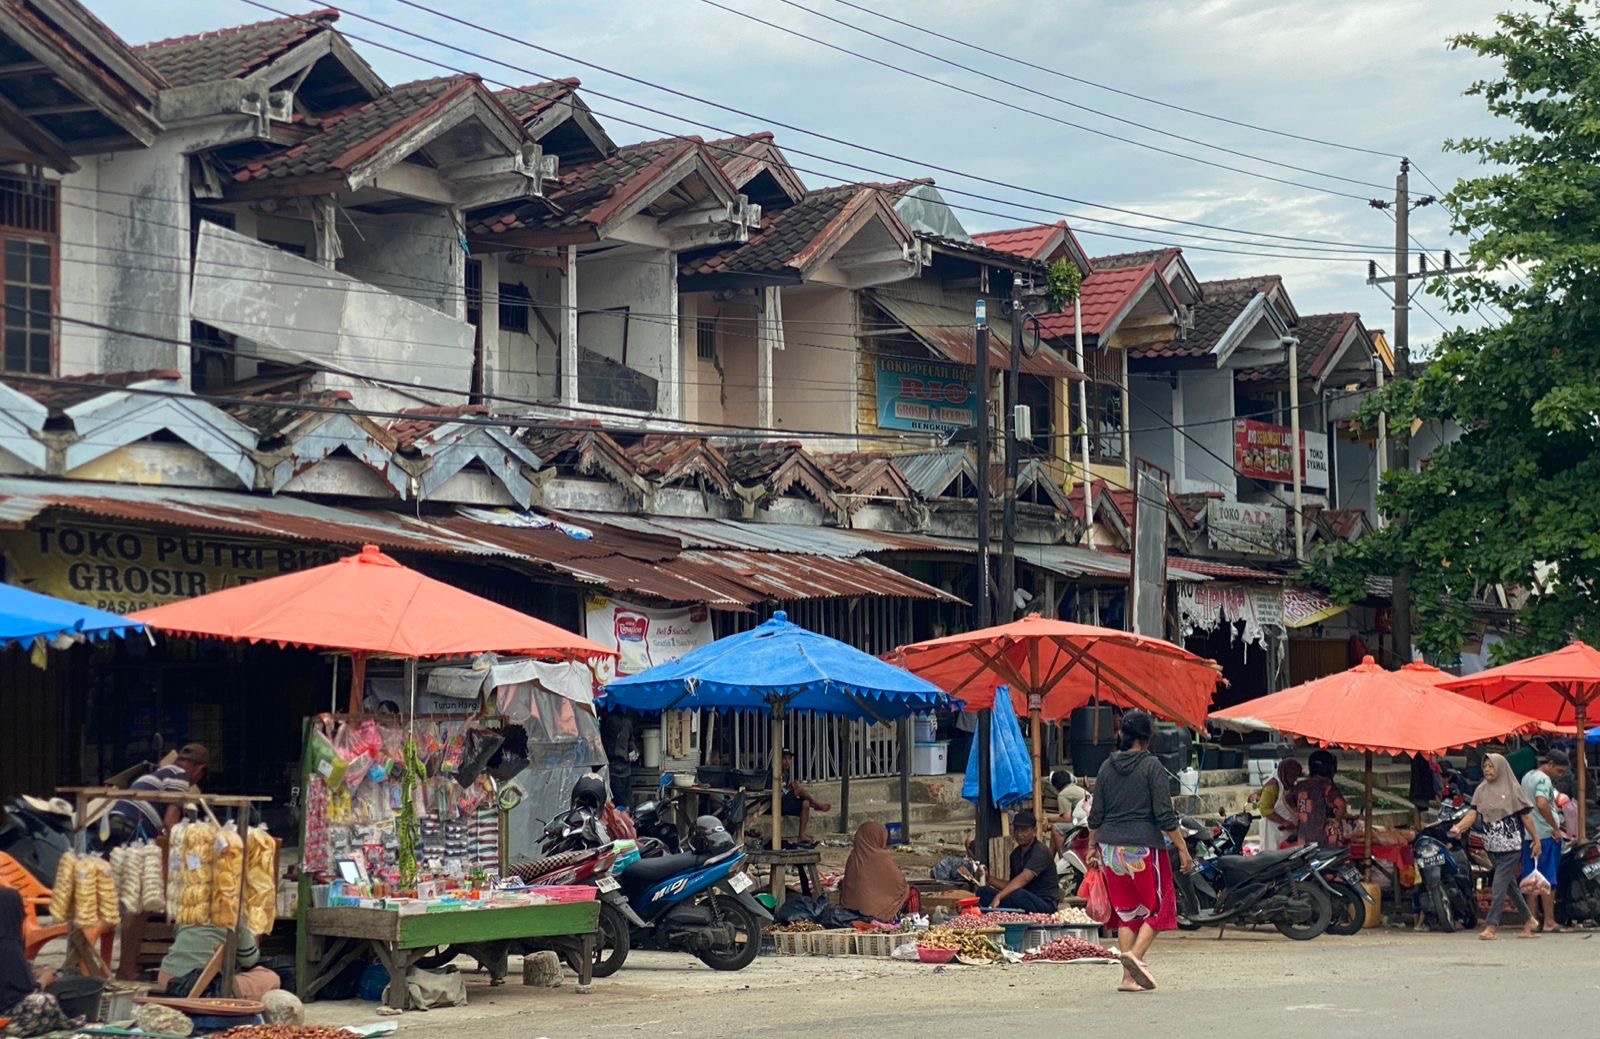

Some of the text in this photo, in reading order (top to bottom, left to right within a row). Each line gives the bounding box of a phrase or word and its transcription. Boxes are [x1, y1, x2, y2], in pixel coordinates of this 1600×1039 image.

[899, 376, 968, 404] RIO
[912, 421, 957, 432] BENGKU
[1309, 448, 1323, 460] TOKO
[1306, 459, 1327, 472] SYAWAL
[1219, 506, 1239, 521] TOKO
[38, 526, 142, 561] TOKO
[156, 535, 264, 570] PUTRI
[69, 562, 207, 598] GROSIR
[433, 701, 457, 709] Turun
